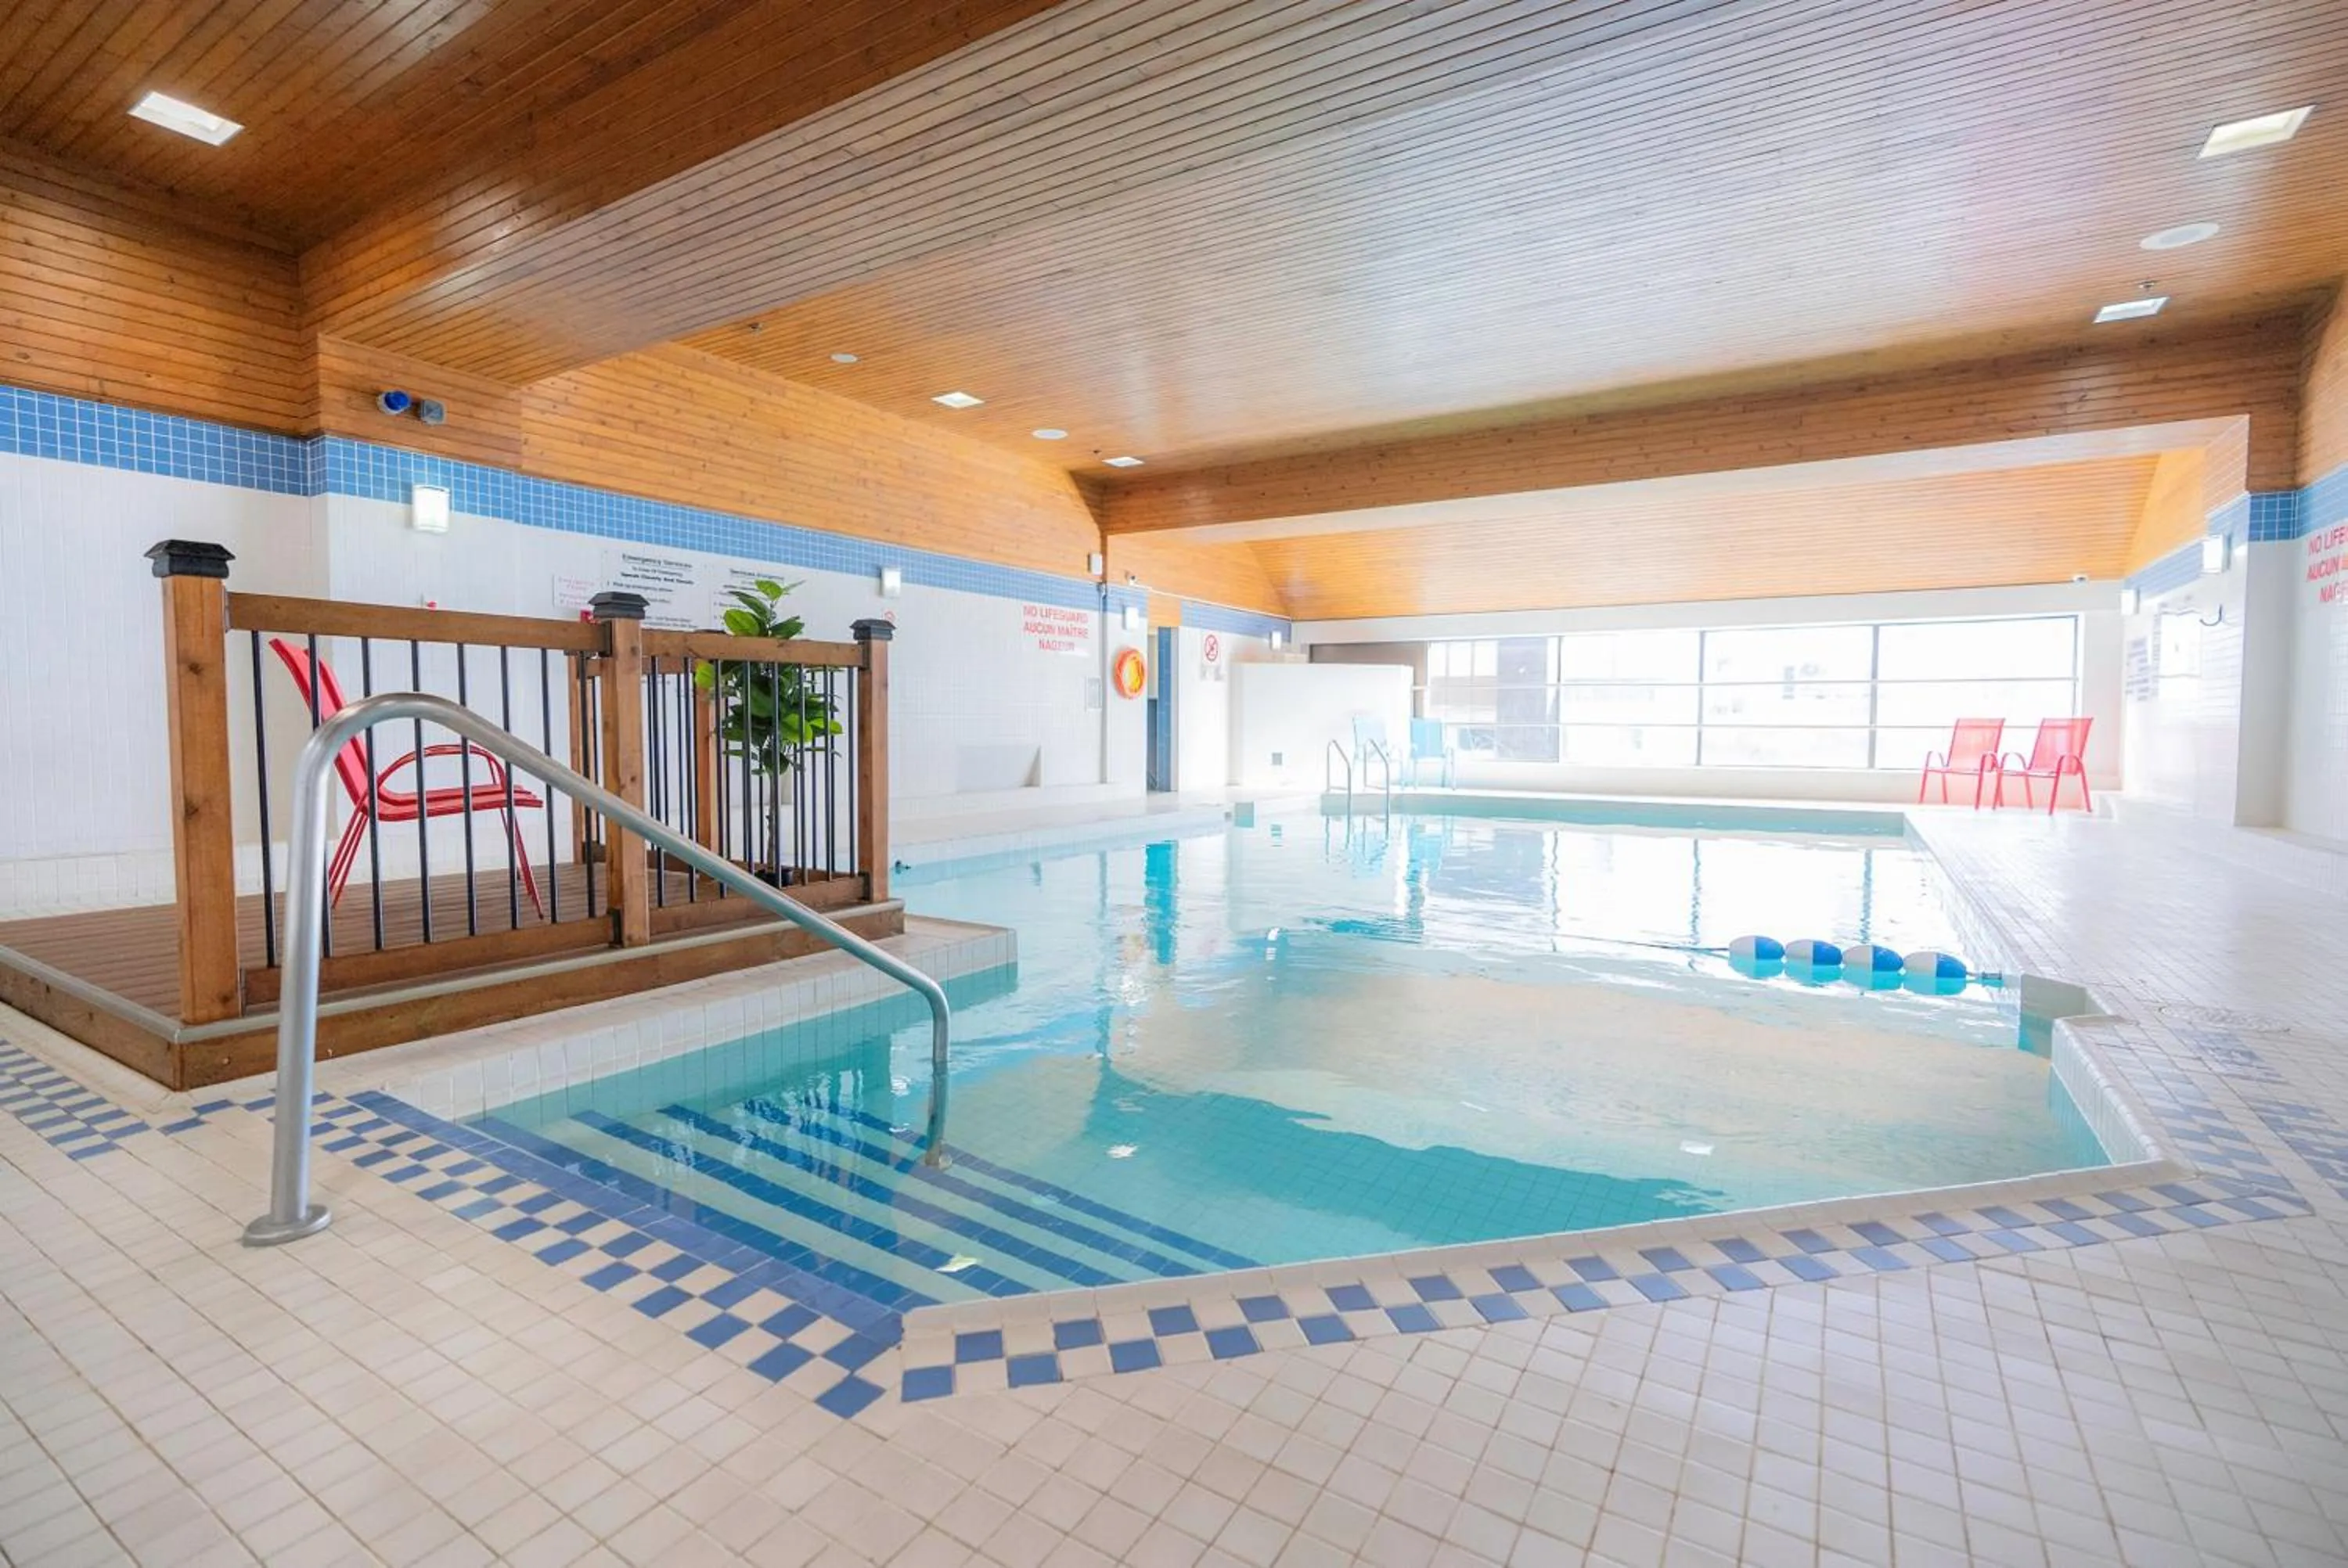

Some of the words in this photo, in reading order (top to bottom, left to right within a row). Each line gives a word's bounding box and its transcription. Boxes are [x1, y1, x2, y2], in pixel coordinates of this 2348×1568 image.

[2308, 535, 2322, 556] NO
[2324, 525, 2348, 550] LIFE
[2306, 556, 2340, 582] AUCUN
[1023, 605, 1038, 617] NO
[1039, 606, 1089, 624] LIFEGUARD
[1023, 620, 1054, 635] AUCUN
[1039, 638, 1075, 652] NAGEUR
